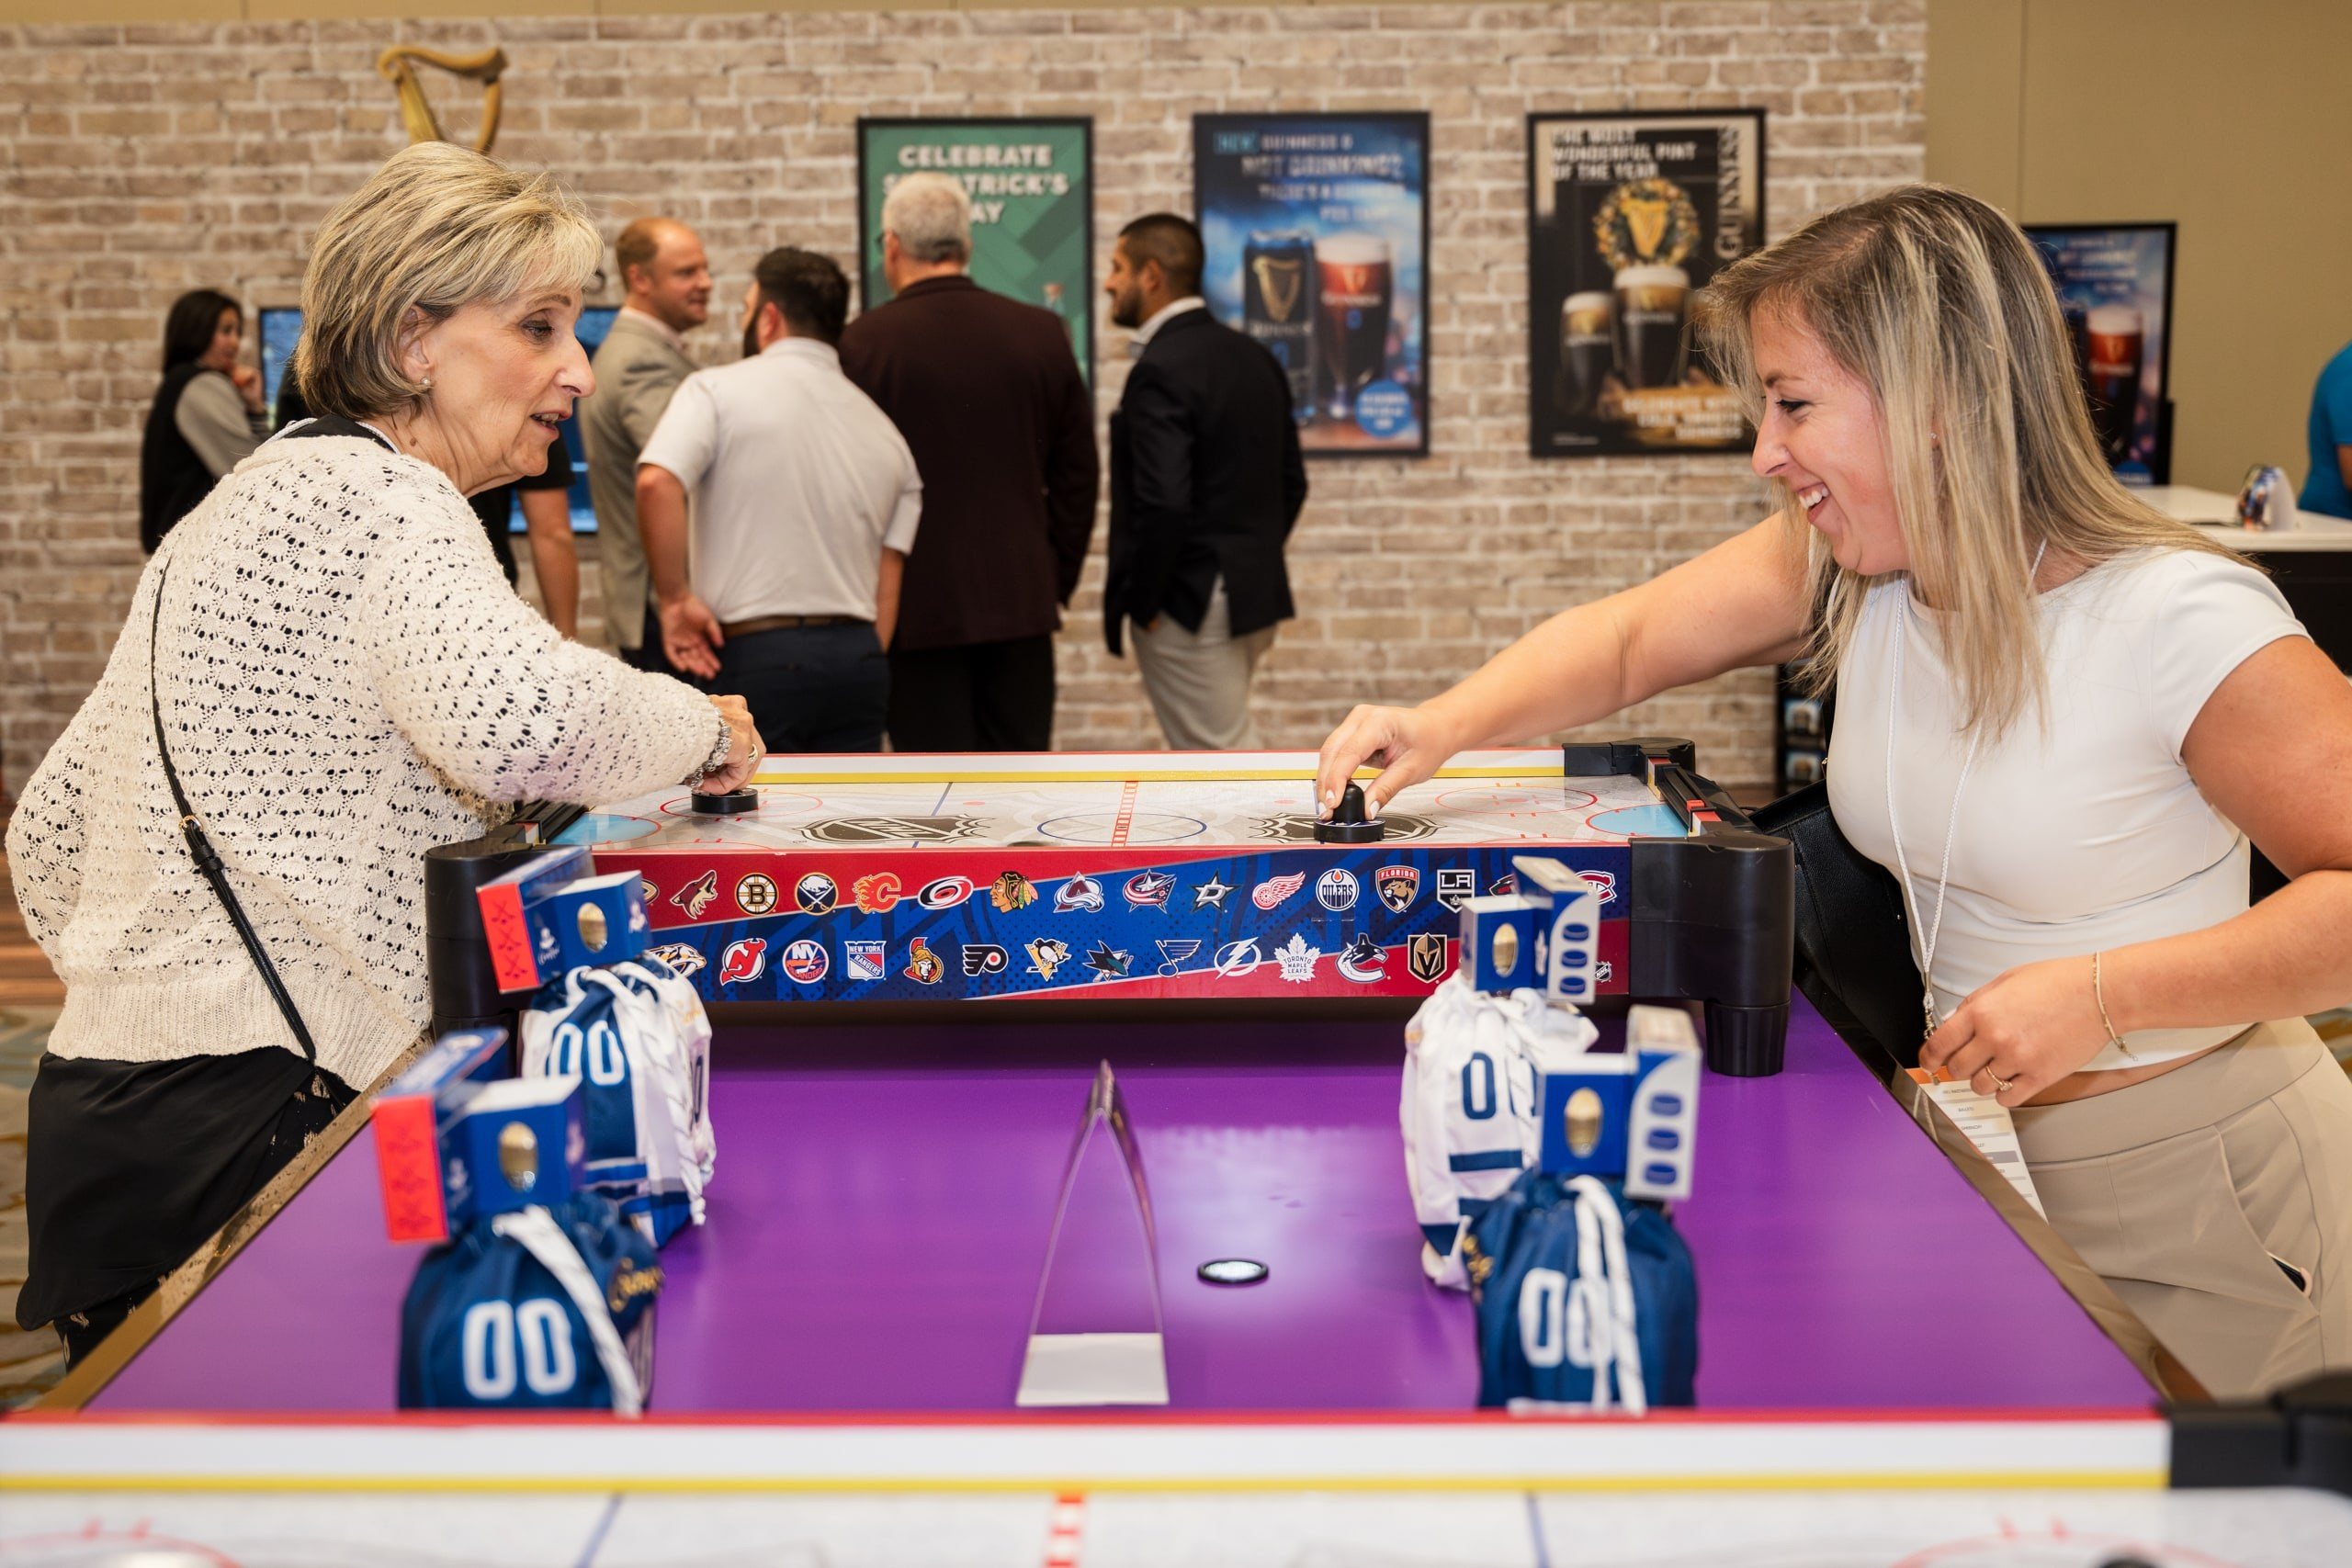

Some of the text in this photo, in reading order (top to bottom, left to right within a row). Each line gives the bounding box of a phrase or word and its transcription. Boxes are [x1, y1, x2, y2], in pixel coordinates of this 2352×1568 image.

[898, 144, 1053, 167] CELEBRATE
[963, 173, 1069, 196] TRICK'S
[970, 201, 1004, 223] AY
[1441, 874, 1470, 887] LA
[854, 954, 882, 976] RANGERS
[549, 1020, 626, 1086] 00
[463, 1297, 577, 1400] 00
